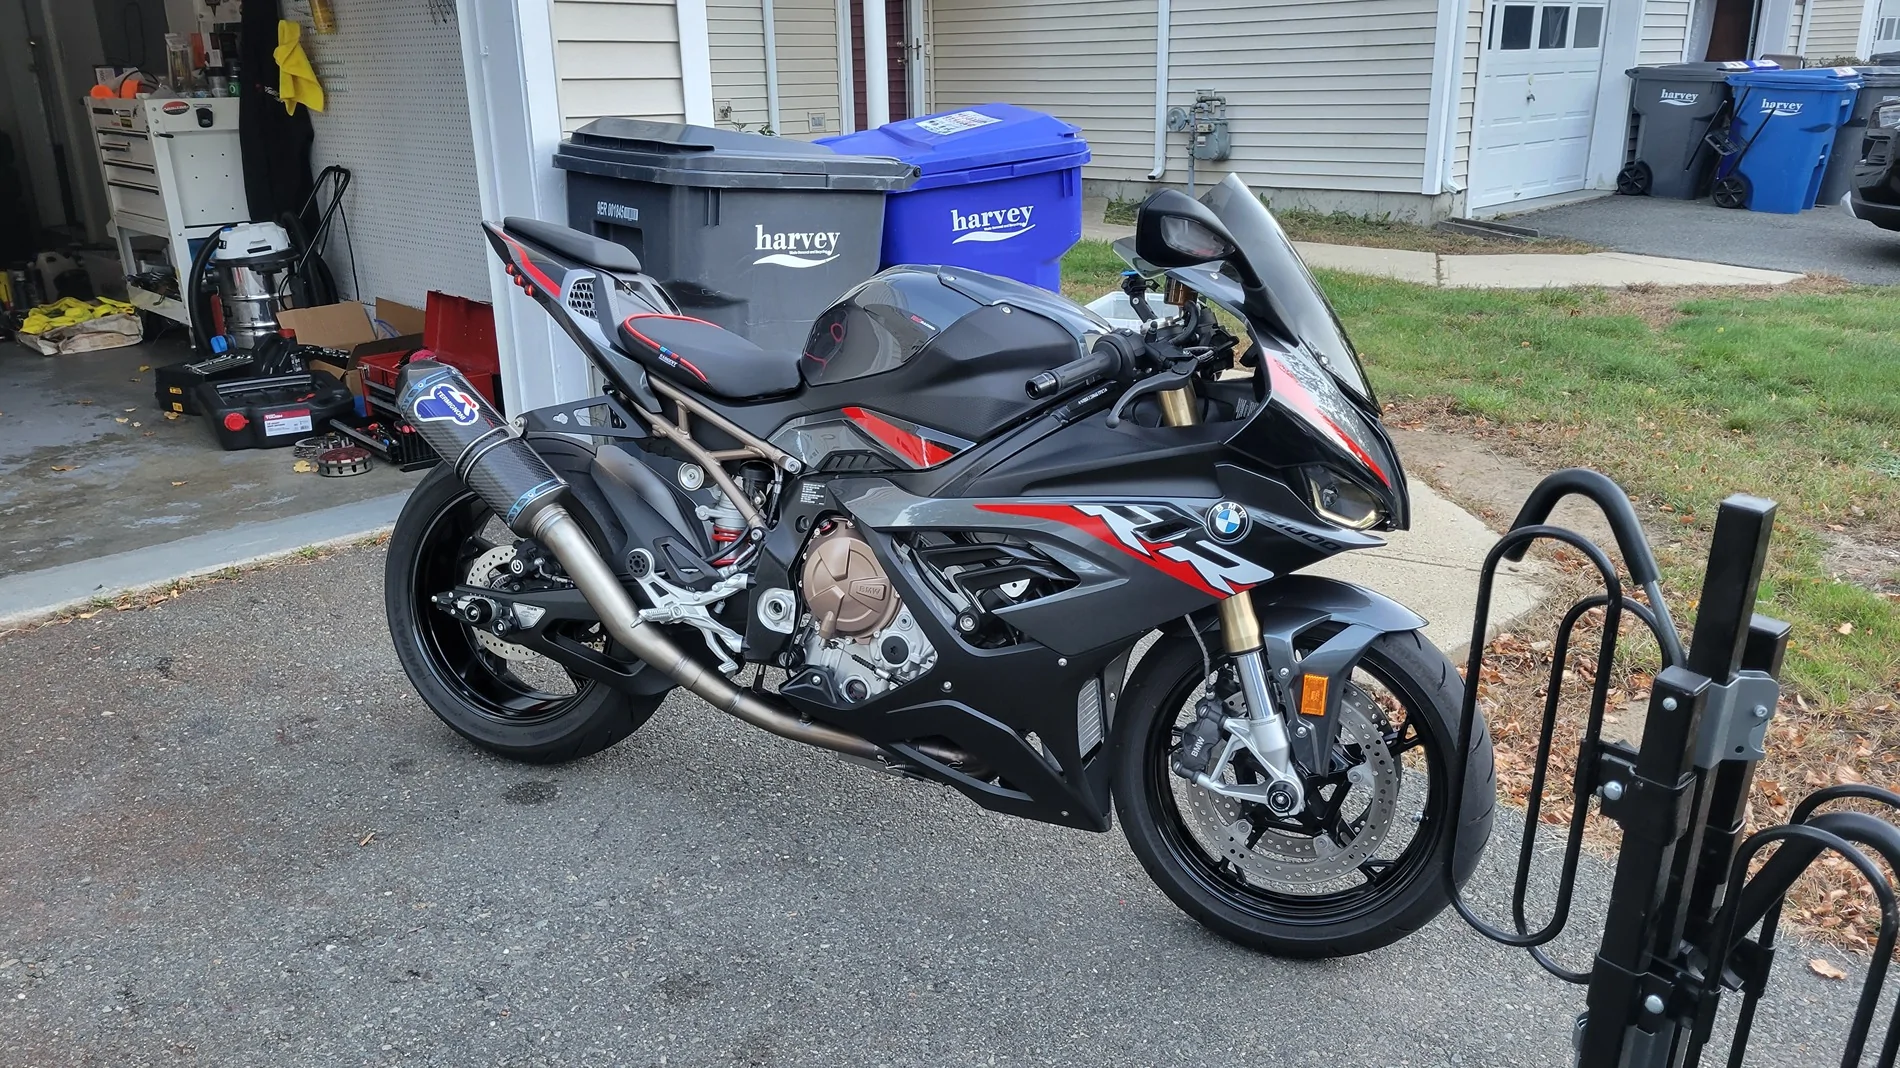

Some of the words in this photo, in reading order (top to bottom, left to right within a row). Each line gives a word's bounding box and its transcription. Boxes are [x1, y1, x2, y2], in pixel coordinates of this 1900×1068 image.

[1661, 89, 1699, 102] harvey
[1762, 98, 1803, 112] harvey
[951, 206, 1034, 231] harvey
[755, 224, 840, 255] harvey
[437, 390, 467, 421] TERMIGNONI
[1215, 502, 1247, 519] BMW
[859, 585, 881, 595] BMW
[1191, 735, 1205, 757] BMW
